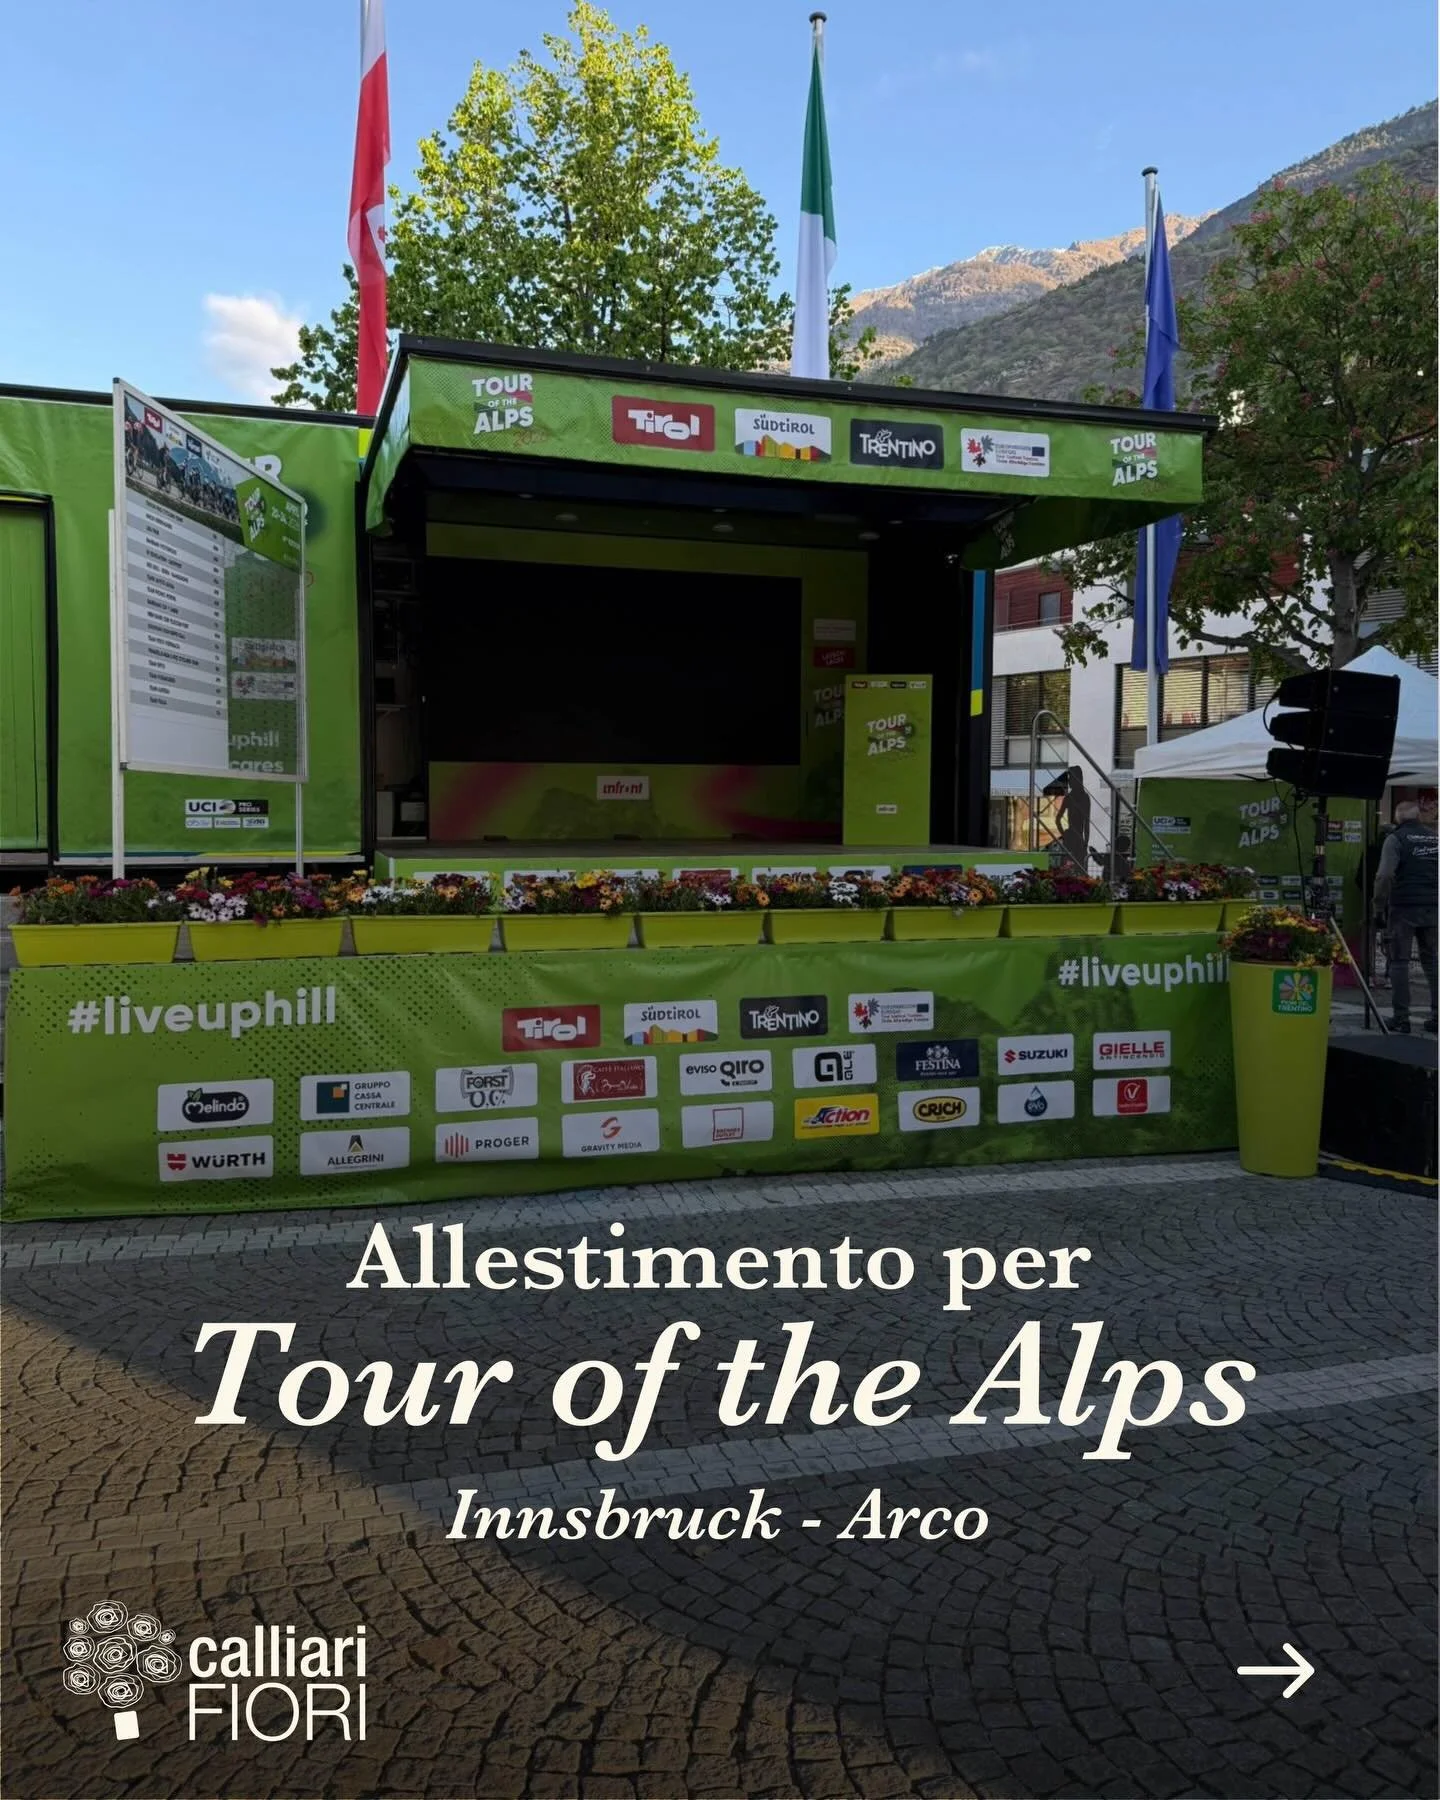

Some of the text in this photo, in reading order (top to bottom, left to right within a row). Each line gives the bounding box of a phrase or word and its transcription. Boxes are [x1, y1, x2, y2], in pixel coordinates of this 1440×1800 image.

[472, 373, 533, 397] TOUR
[488, 397, 517, 408] OF THE
[473, 406, 534, 435] ALPS
[1110, 431, 1157, 455] TOUR
[1122, 452, 1145, 464] OF THE
[1112, 460, 1158, 487] ALPS
[813, 684, 843, 705] TOU
[814, 707, 844, 729] ALP
[866, 713, 906, 734] TOUR
[867, 736, 906, 757] ALPS
[188, 801, 217, 813] UCI
[1239, 796, 1281, 820] TOUR
[1238, 824, 1280, 848] ALPS
[67, 986, 336, 1038] #liveuphill
[1018, 1049, 1068, 1061] SUZUKI
[1099, 1041, 1165, 1056] GIELLE
[915, 1058, 961, 1071] FESTINA
[354, 1081, 391, 1091] GRUPPO
[466, 1075, 508, 1089] FORST
[354, 1091, 382, 1100] CASSA
[354, 1100, 396, 1111] CENTRALE
[918, 1101, 961, 1117] CRICH
[475, 1136, 530, 1150] PROGER
[581, 1141, 642, 1153] GRAVITY MEDIA
[192, 1152, 266, 1169] WÜRTH
[327, 1153, 385, 1167] ALLEGRINI
